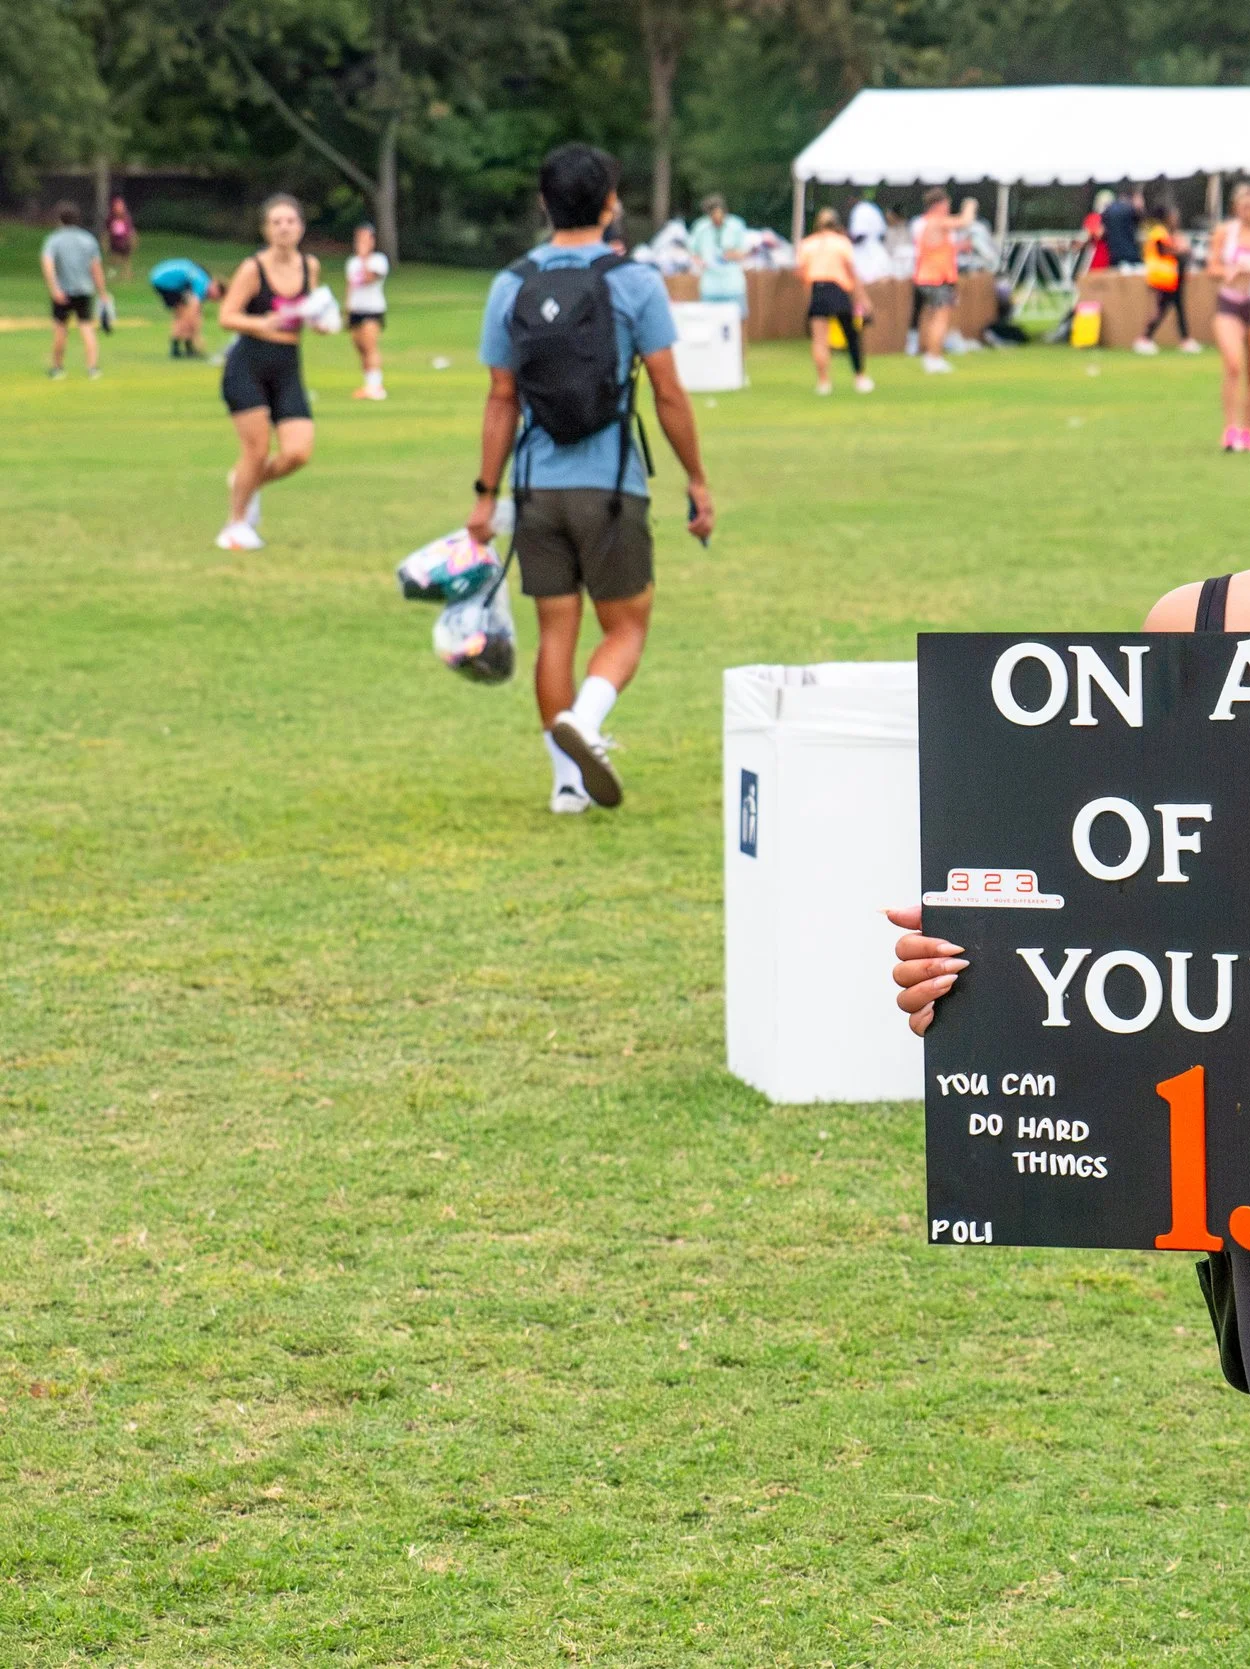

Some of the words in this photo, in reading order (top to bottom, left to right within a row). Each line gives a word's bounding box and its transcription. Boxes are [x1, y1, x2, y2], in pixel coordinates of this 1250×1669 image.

[991, 642, 1150, 727] ON
[1072, 796, 1213, 882] OF
[936, 1073, 989, 1097] YOU
[969, 1112, 1003, 1137] DO
[1018, 1116, 1090, 1142] HARD
[1012, 1150, 1108, 1179] THINGS
